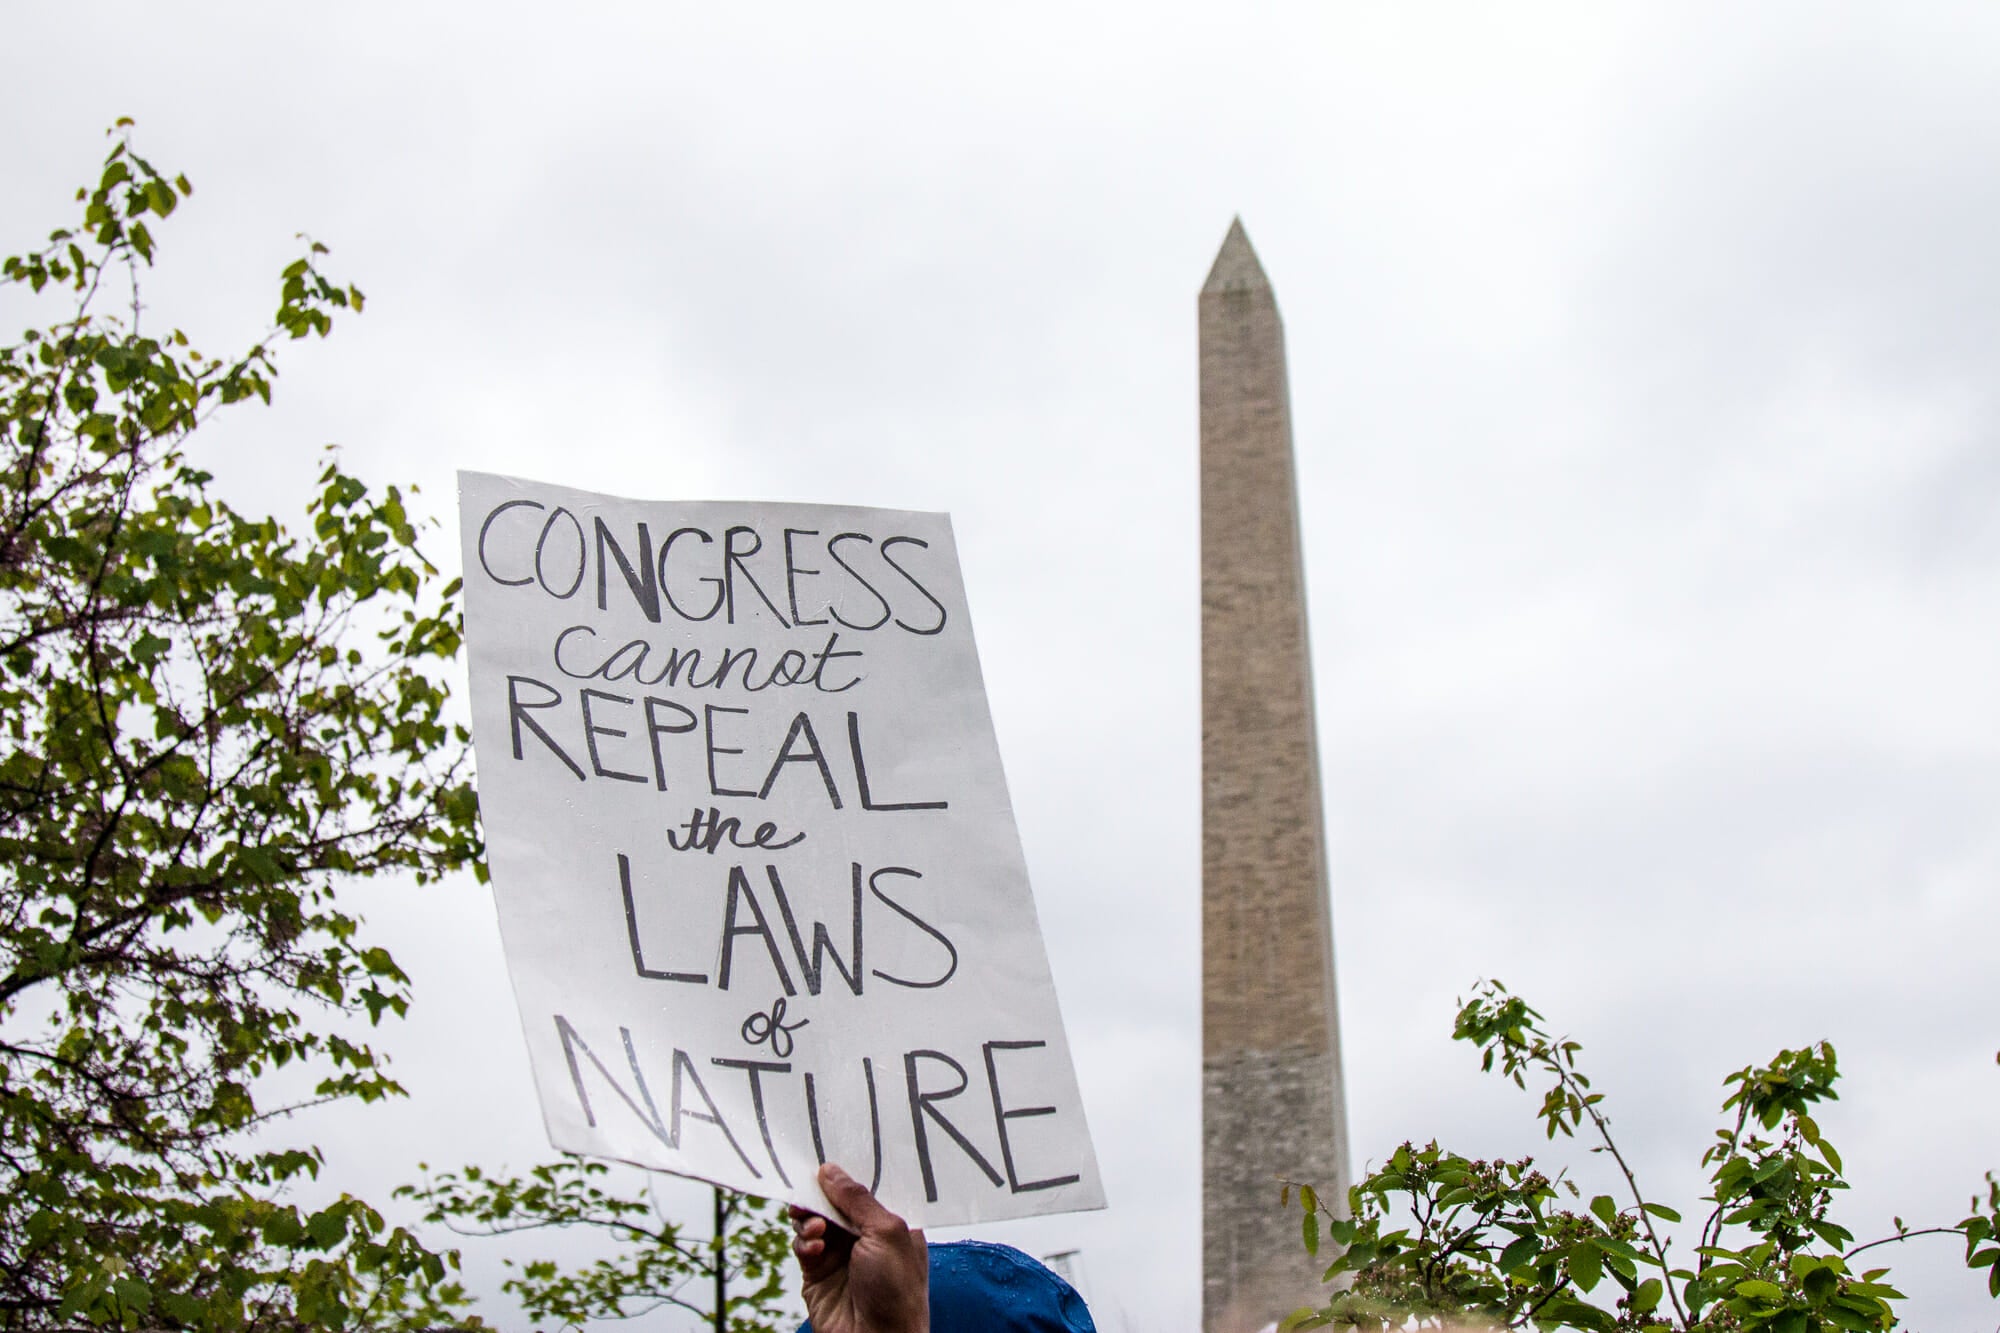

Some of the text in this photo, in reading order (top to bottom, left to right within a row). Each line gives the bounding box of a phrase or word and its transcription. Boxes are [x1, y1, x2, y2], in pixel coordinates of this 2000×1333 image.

[479, 500, 947, 635] CONGRESS
[506, 675, 948, 811] REPEAL
[667, 807, 806, 853] the
[617, 853, 957, 997] LAWS
[741, 997, 810, 1058] of
[554, 1015, 1080, 1204] NATURE
